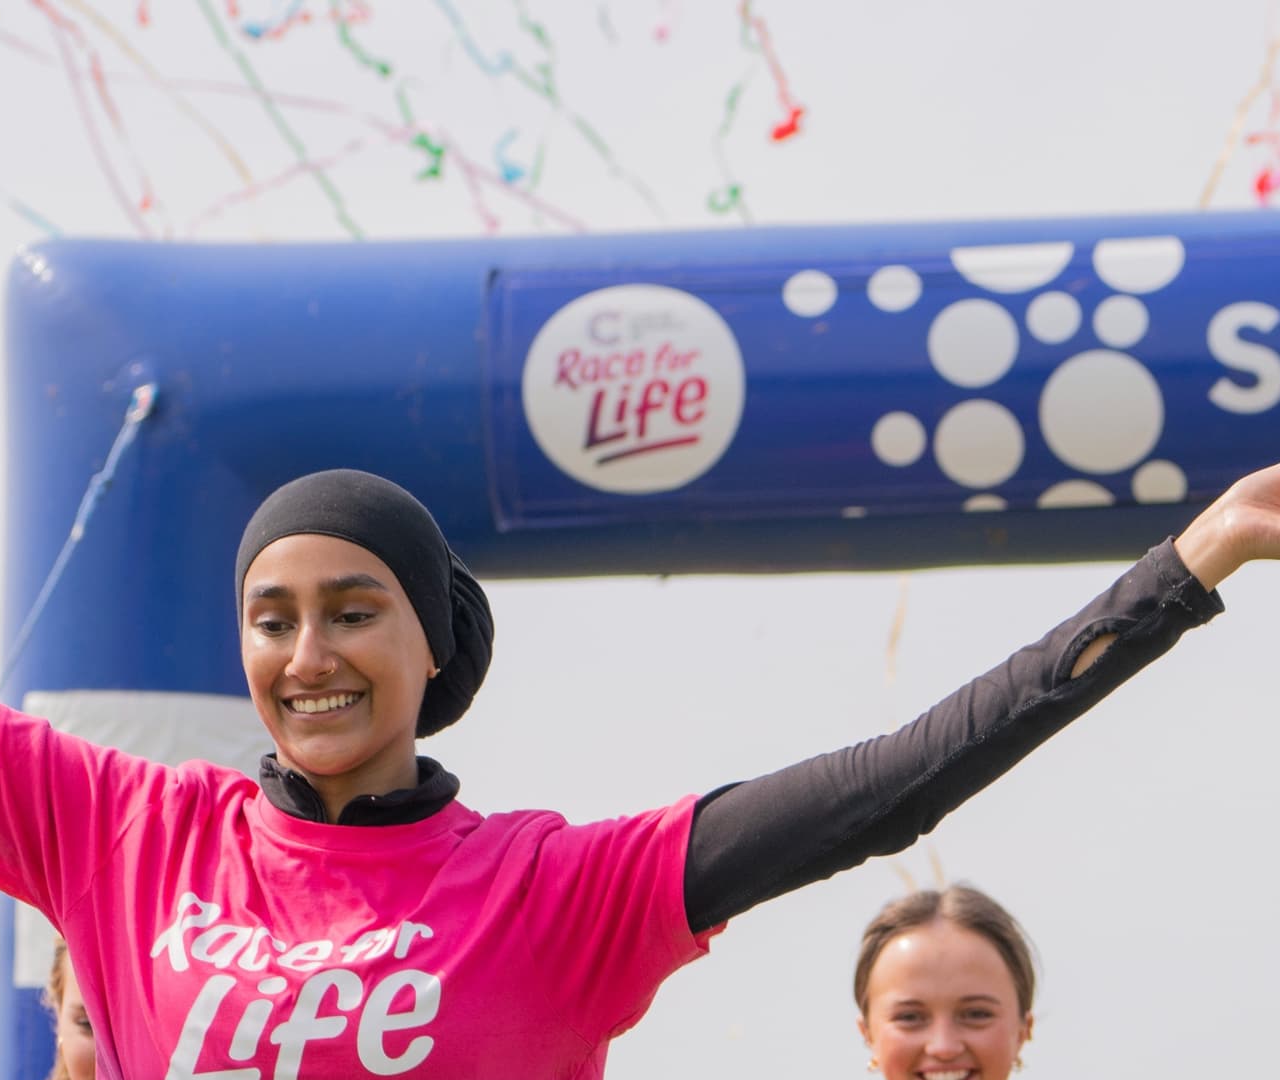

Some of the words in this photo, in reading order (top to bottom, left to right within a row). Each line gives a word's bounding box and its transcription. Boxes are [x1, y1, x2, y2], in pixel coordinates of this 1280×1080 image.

[555, 349, 644, 391] Race
[653, 342, 699, 374] for
[583, 376, 708, 450] Life
[150, 892, 333, 972] Race
